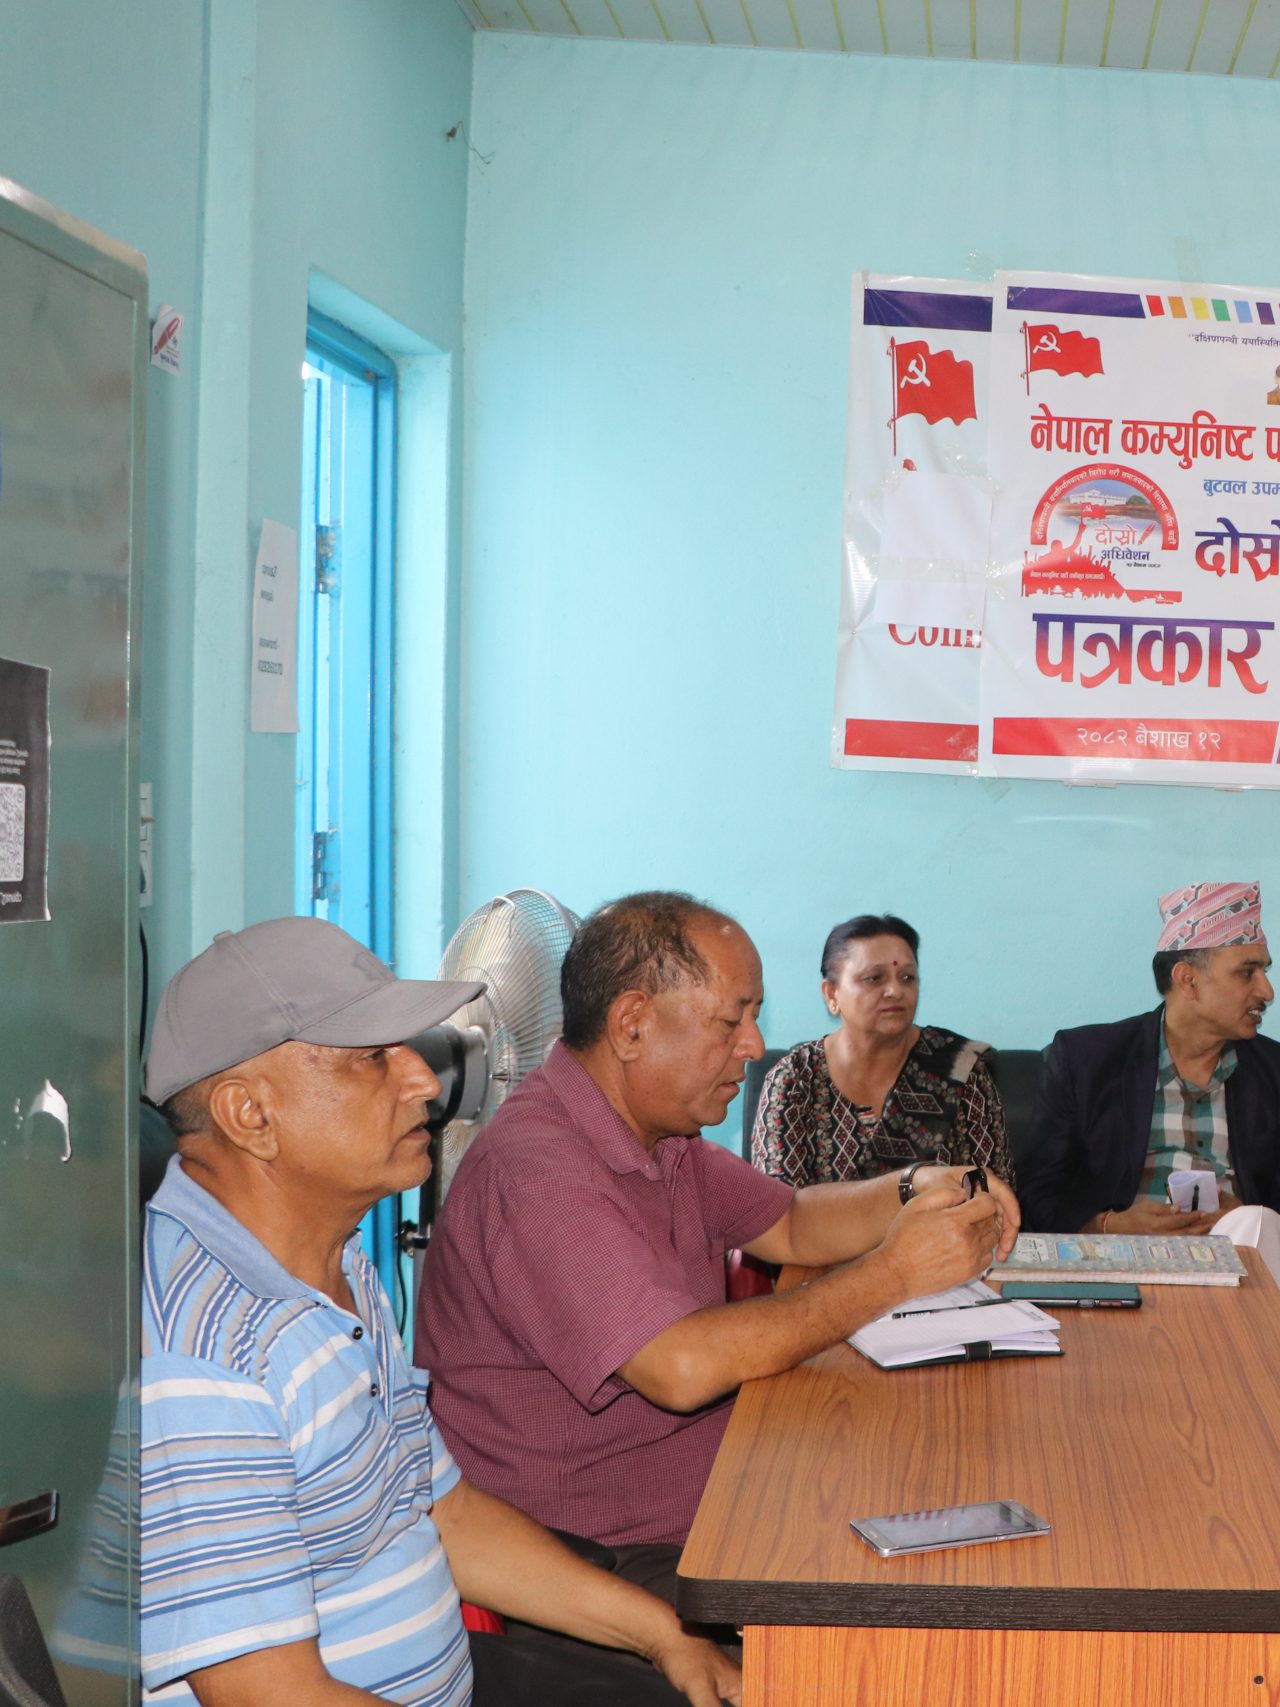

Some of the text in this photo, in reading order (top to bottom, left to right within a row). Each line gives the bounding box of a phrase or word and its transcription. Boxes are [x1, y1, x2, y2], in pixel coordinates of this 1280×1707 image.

[1030, 403, 1112, 456] नेपाल
[1121, 410, 1256, 469] कम्युनिष्ट
[1203, 479, 1248, 497] बुटवल
[1095, 521, 1139, 546] दोस्रो
[1100, 545, 1151, 561] अधिवेशन
[888, 623, 982, 648] Com
[1032, 612, 1275, 695] पत्रकार
[1076, 722, 1221, 751] २०८२ बैशाख १२
